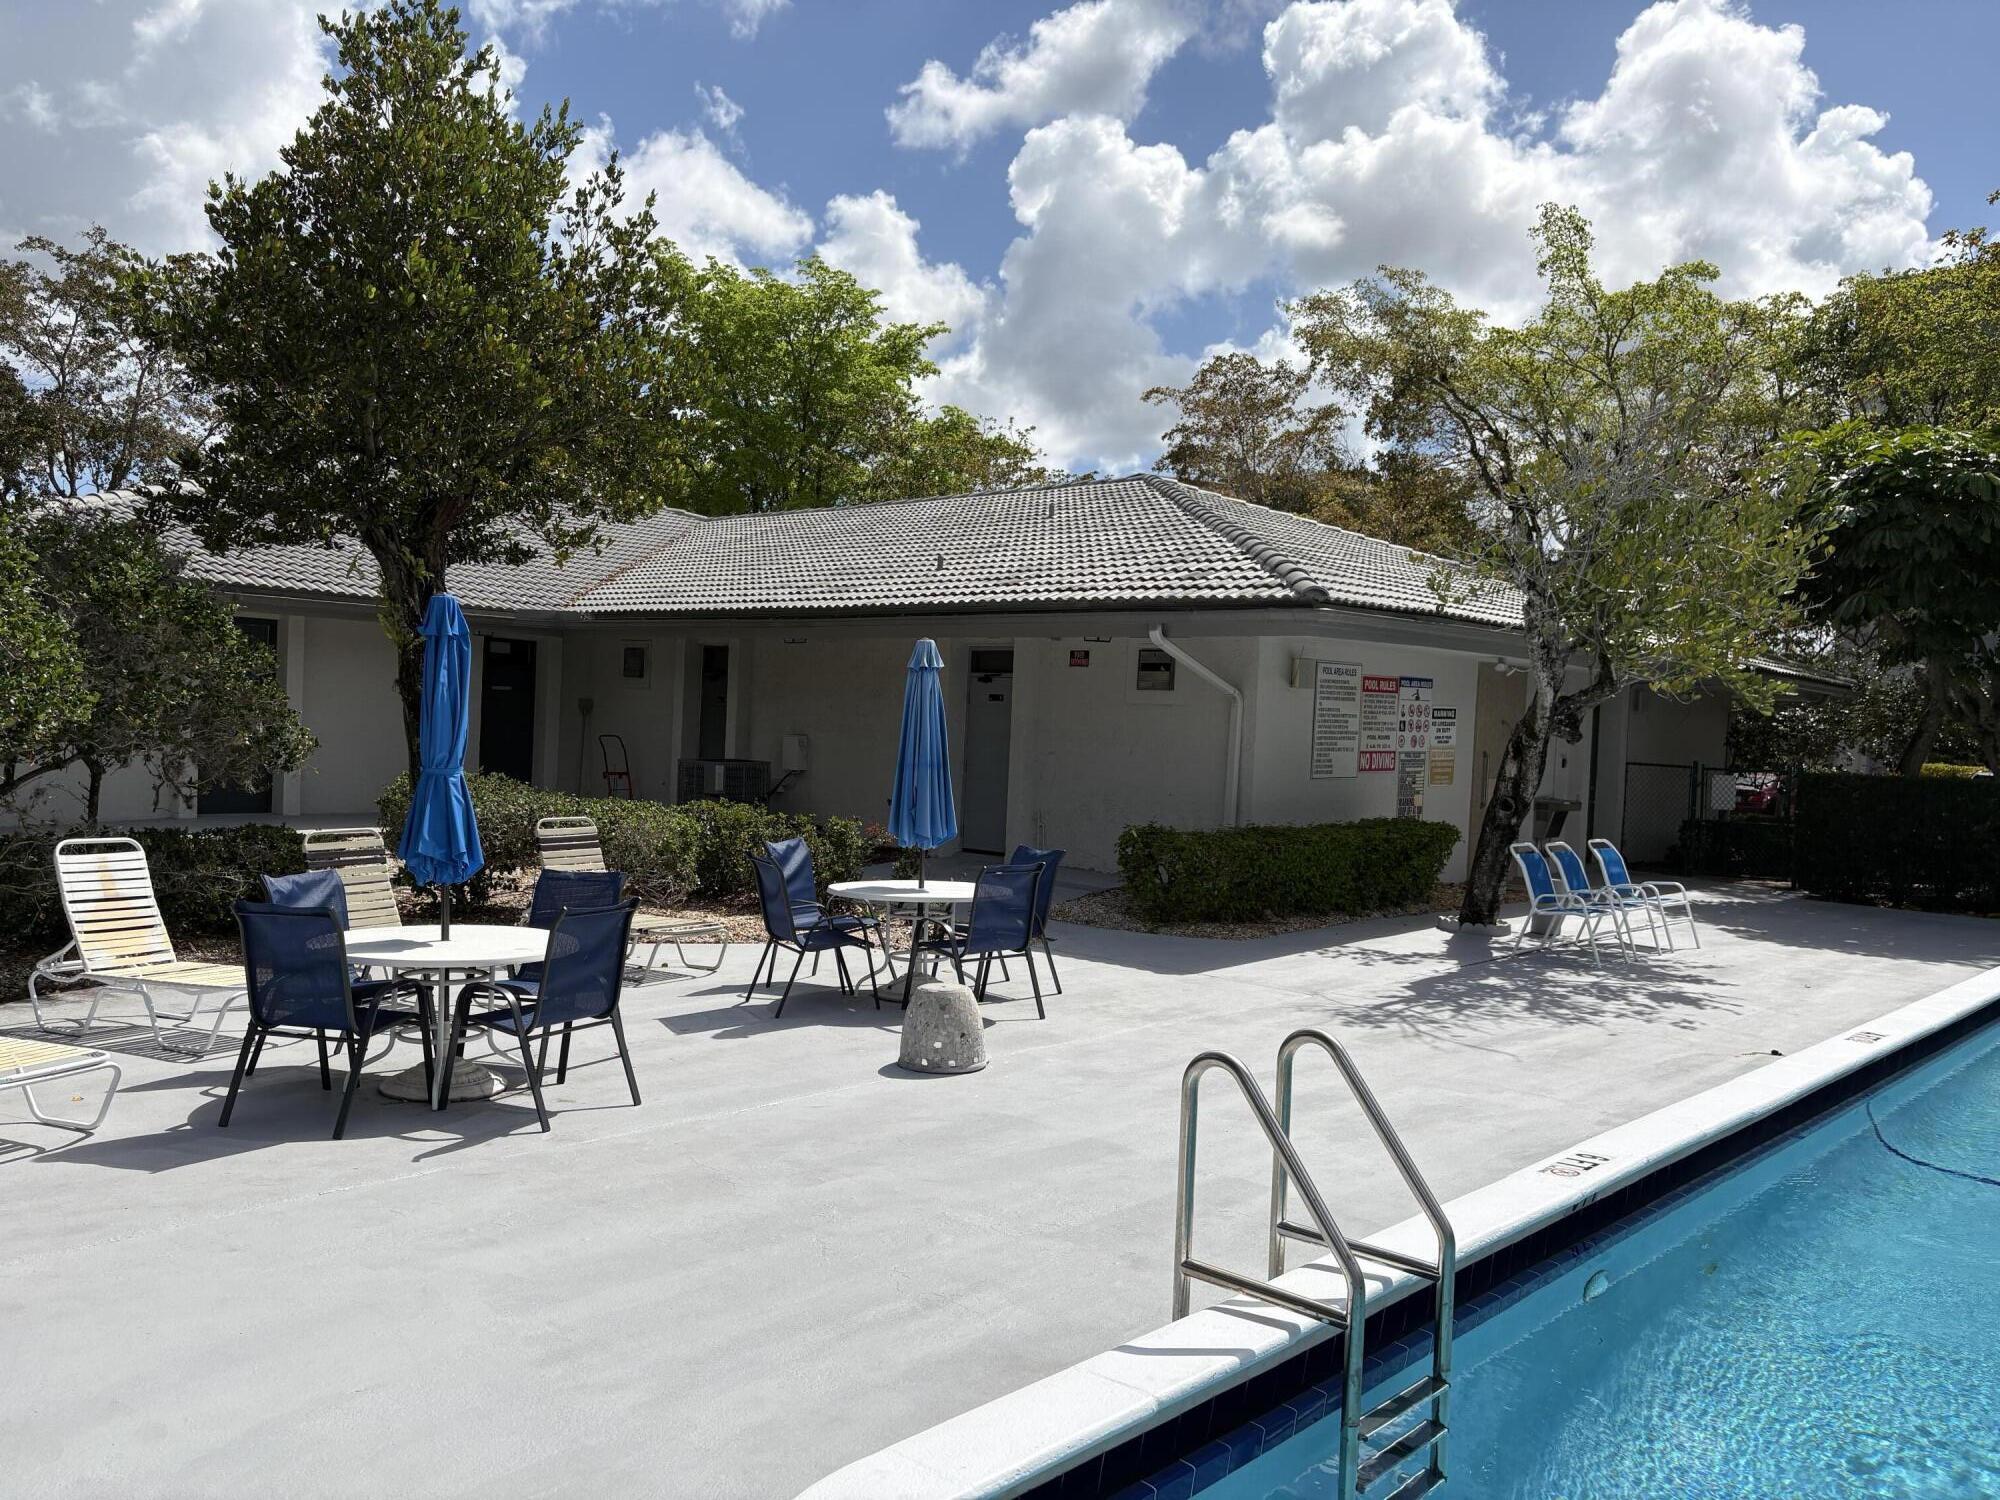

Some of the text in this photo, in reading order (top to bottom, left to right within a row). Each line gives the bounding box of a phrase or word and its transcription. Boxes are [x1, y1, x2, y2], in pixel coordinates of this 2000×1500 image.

[1323, 666, 1357, 676] POOL AREA RULES
[1364, 679, 1378, 690] POOL
[1380, 680, 1396, 691] RULES
[1360, 752, 1395, 770] NO DIVING
